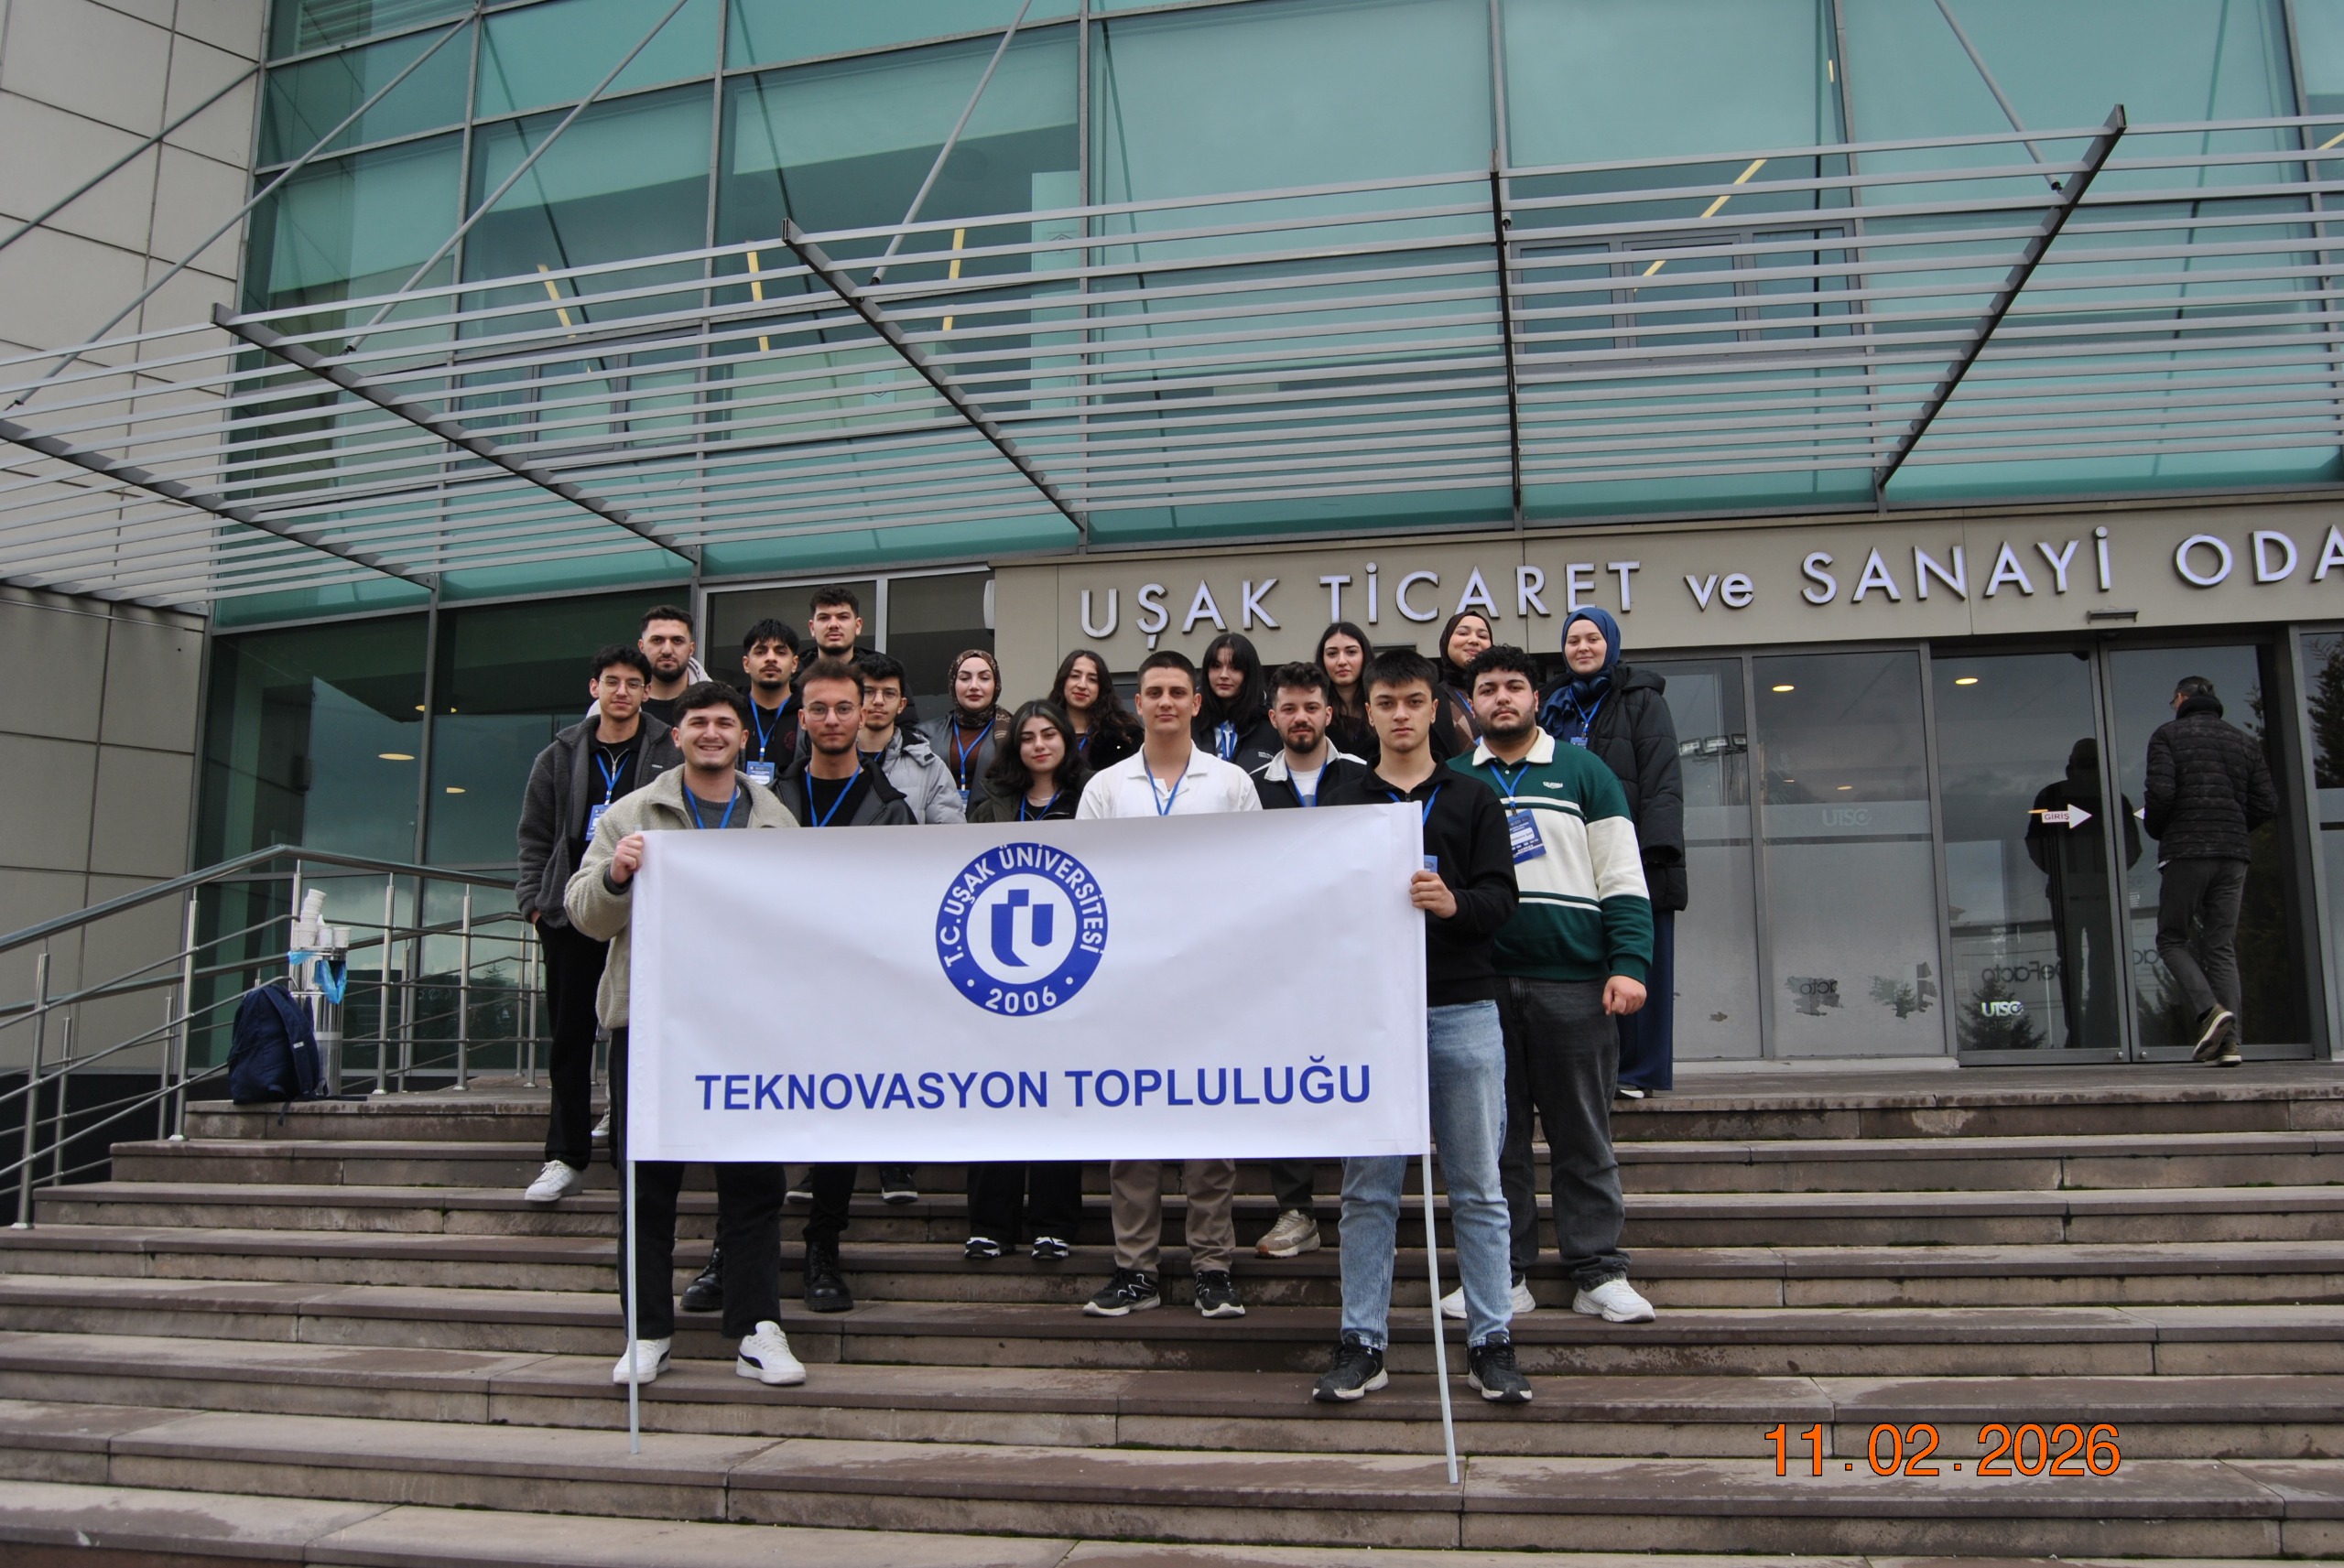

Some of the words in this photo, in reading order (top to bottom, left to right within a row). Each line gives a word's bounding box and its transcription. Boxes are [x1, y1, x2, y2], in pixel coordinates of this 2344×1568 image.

[1080, 578, 1280, 650] UŞAK
[1319, 560, 1641, 624] TİCARET
[1684, 571, 1754, 611] ve
[1800, 525, 2112, 605] SANAYİ
[2174, 524, 2344, 589] ODA
[998, 843, 1104, 955] ÜNİVERSİTESİ
[985, 986, 1057, 1013] 2006
[695, 1071, 1047, 1111] TEKNOVASYON
[1064, 1055, 1372, 1108] TOPLULUĞU
